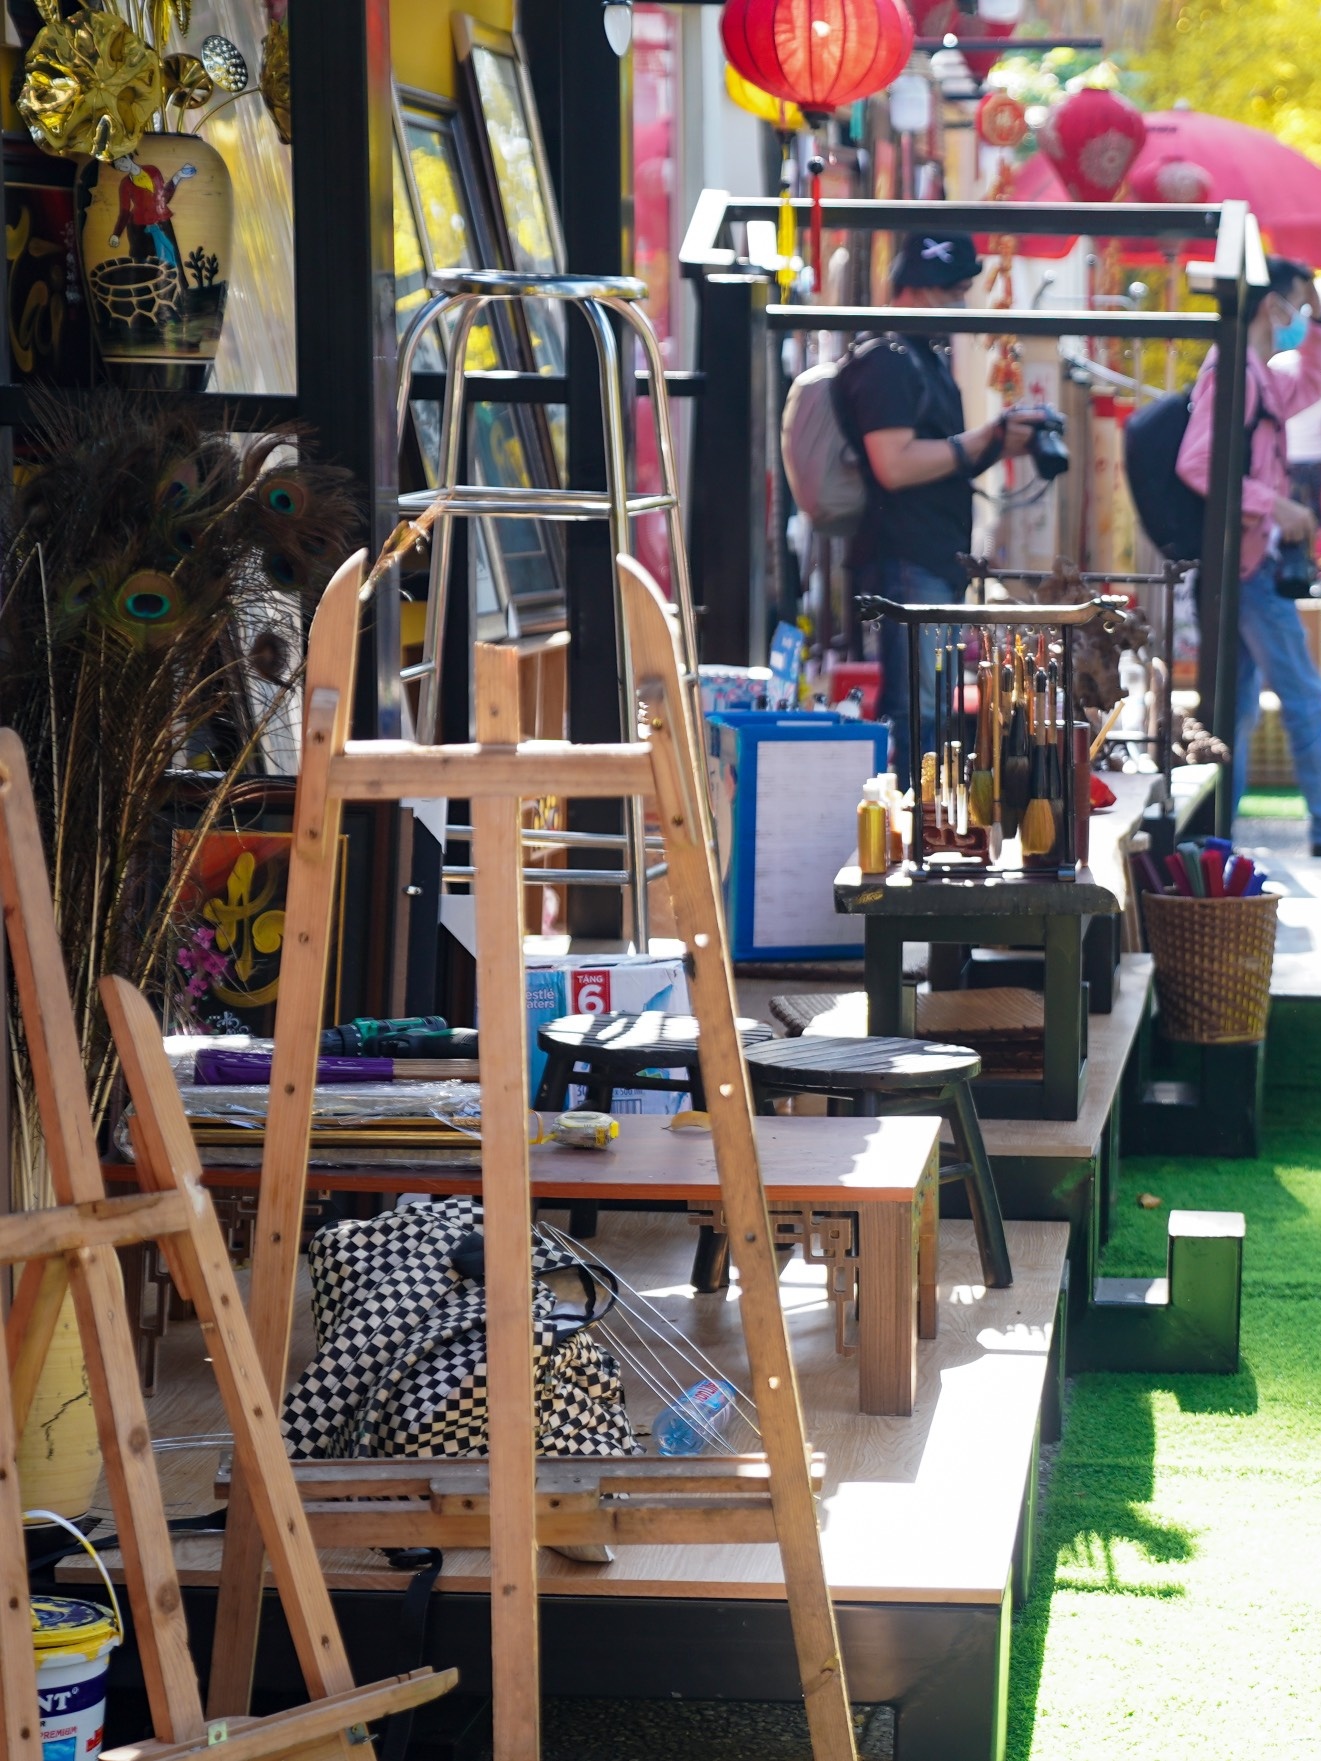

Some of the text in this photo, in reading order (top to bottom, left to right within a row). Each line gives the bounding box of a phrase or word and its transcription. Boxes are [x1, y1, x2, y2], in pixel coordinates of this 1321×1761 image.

[526, 988, 555, 999] estlé
[578, 984, 604, 1014] 6
[526, 1000, 555, 1009] aters
